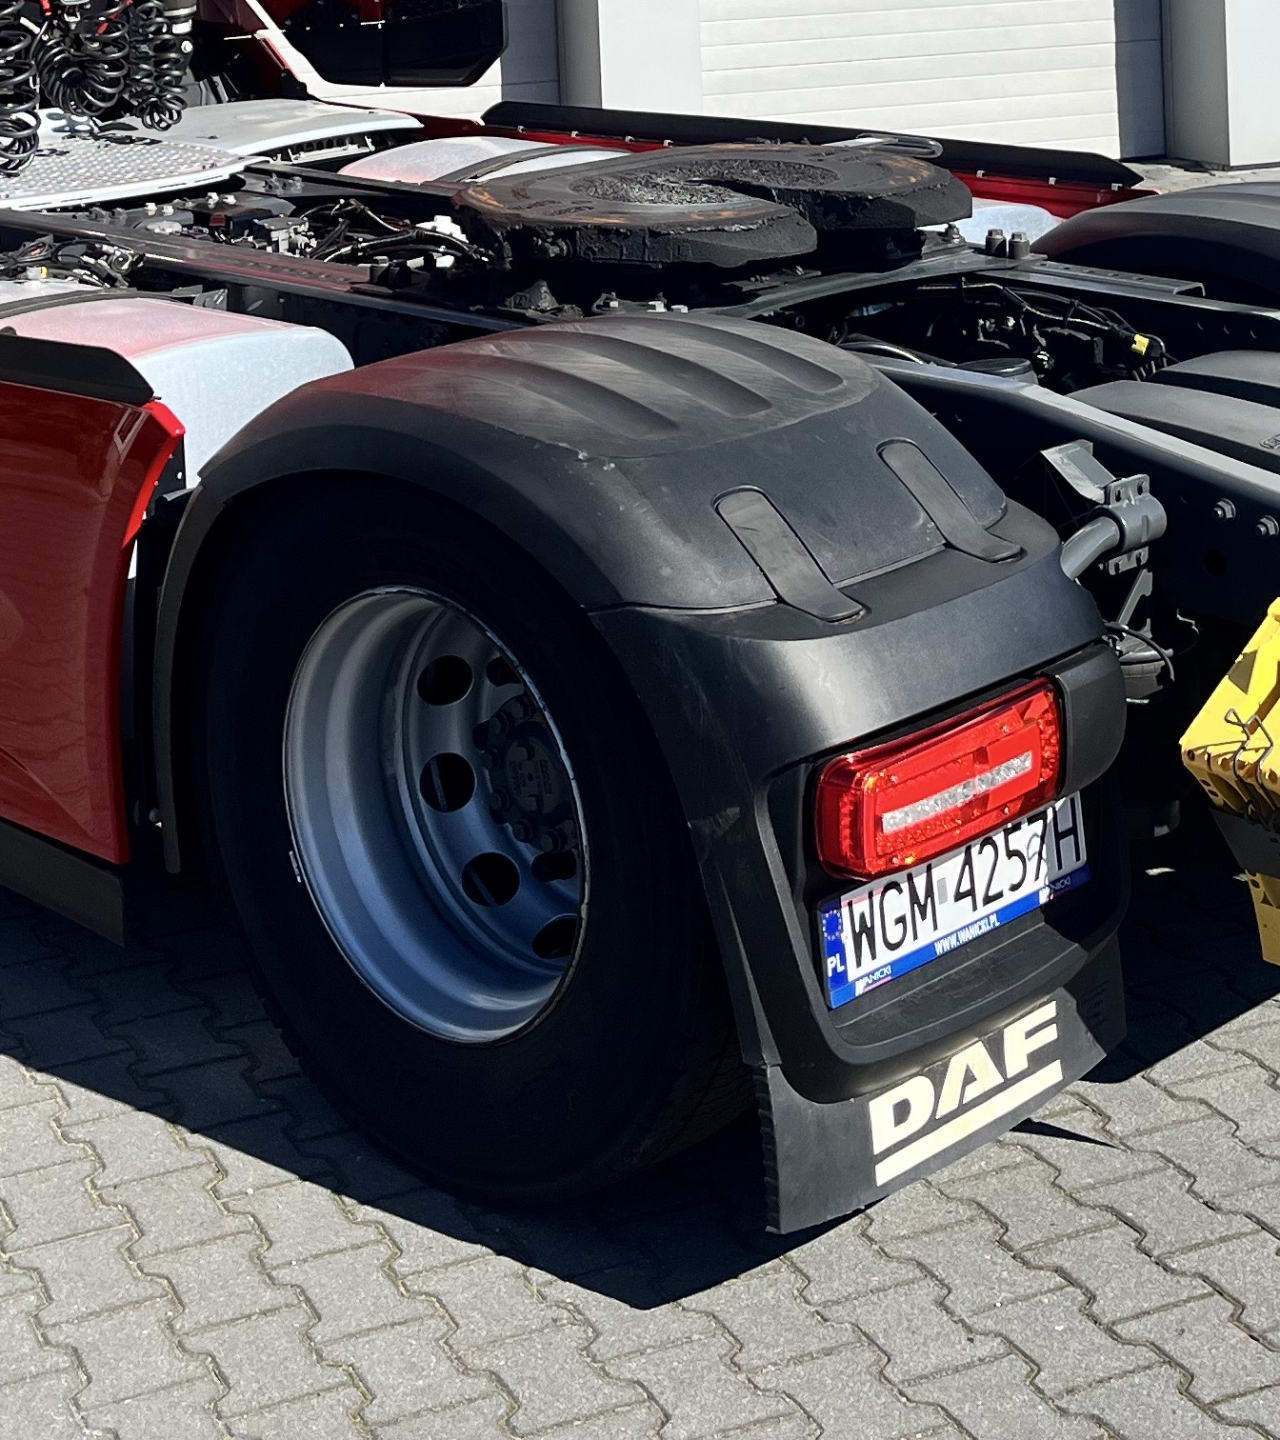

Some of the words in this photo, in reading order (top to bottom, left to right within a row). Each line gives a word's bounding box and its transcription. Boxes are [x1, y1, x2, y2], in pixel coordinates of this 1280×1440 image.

[846, 863, 939, 969] WGM
[952, 798, 1082, 913] 4257H
[827, 953, 846, 978] PL
[867, 1000, 1059, 1157] DAF
